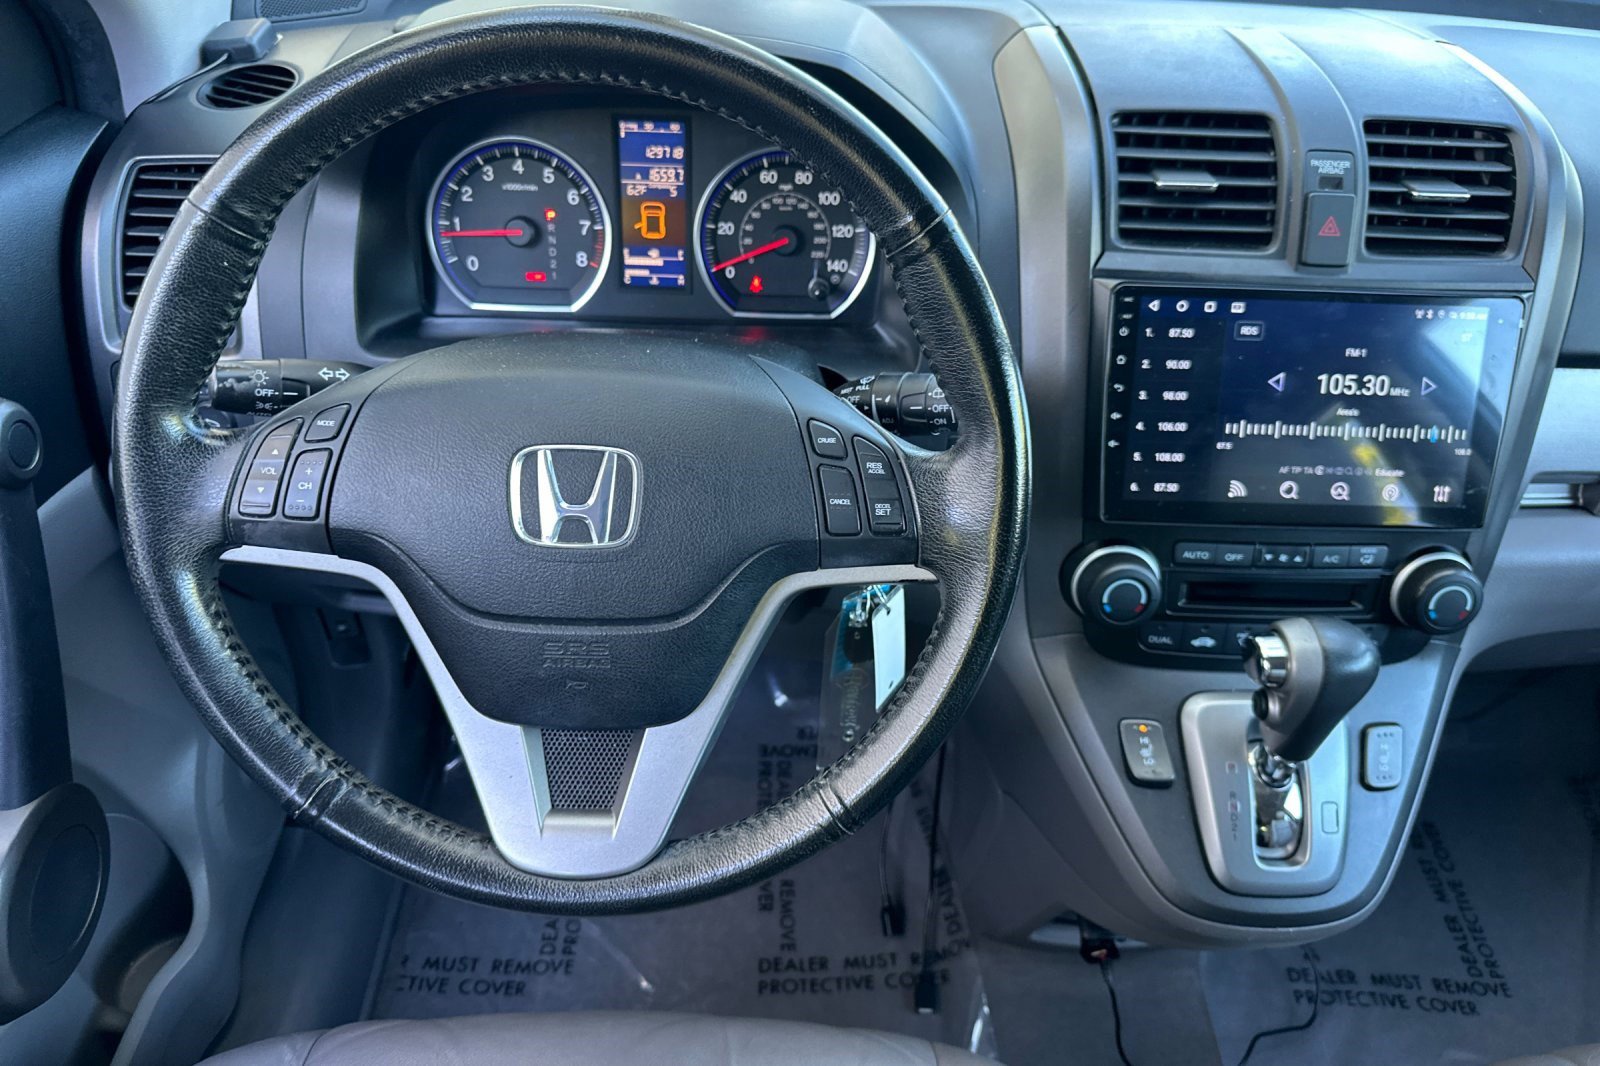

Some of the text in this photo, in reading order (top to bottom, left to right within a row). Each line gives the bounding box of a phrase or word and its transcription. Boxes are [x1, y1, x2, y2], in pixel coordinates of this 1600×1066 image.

[482, 166, 495, 182] 3
[512, 159, 524, 175] 4
[542, 169, 555, 184] 5
[759, 170, 778, 184] 60
[794, 170, 813, 185] 80
[461, 186, 473, 203] 2
[567, 189, 580, 205] 6
[730, 189, 747, 203] 40
[818, 192, 840, 206] 100
[453, 217, 461, 232] 1
[579, 220, 591, 236] 7
[717, 222, 735, 235] 20
[832, 225, 853, 238] 120
[466, 255, 479, 272] 0
[576, 251, 588, 268] 8
[826, 259, 848, 272] 140
[725, 266, 736, 279] 0
[1168, 328, 1195, 338] 87.50
[1240, 325, 1260, 336] RDS
[1317, 373, 1410, 396] 105.30 MHz
[255, 388, 275, 397] OFF
[931, 404, 950, 413] OFF
[316, 419, 335, 427] MODE
[260, 466, 277, 475] VOL
[297, 480, 313, 490] CH
[875, 508, 892, 516] SET
[1183, 550, 1209, 560] AUTO
[1224, 552, 1244, 562] OFF
[1322, 555, 1339, 563] A/C
[1148, 635, 1172, 645] DUAL
[422, 955, 479, 973] MUST
[490, 958, 574, 976] REMOVE
[758, 956, 828, 974] DEALER
[844, 952, 897, 969] MUST
[458, 978, 526, 996] COVER
[758, 974, 875, 996] PROTECTIVE
[1370, 972, 1423, 991] MUST
[1416, 995, 1481, 1017] COVER
